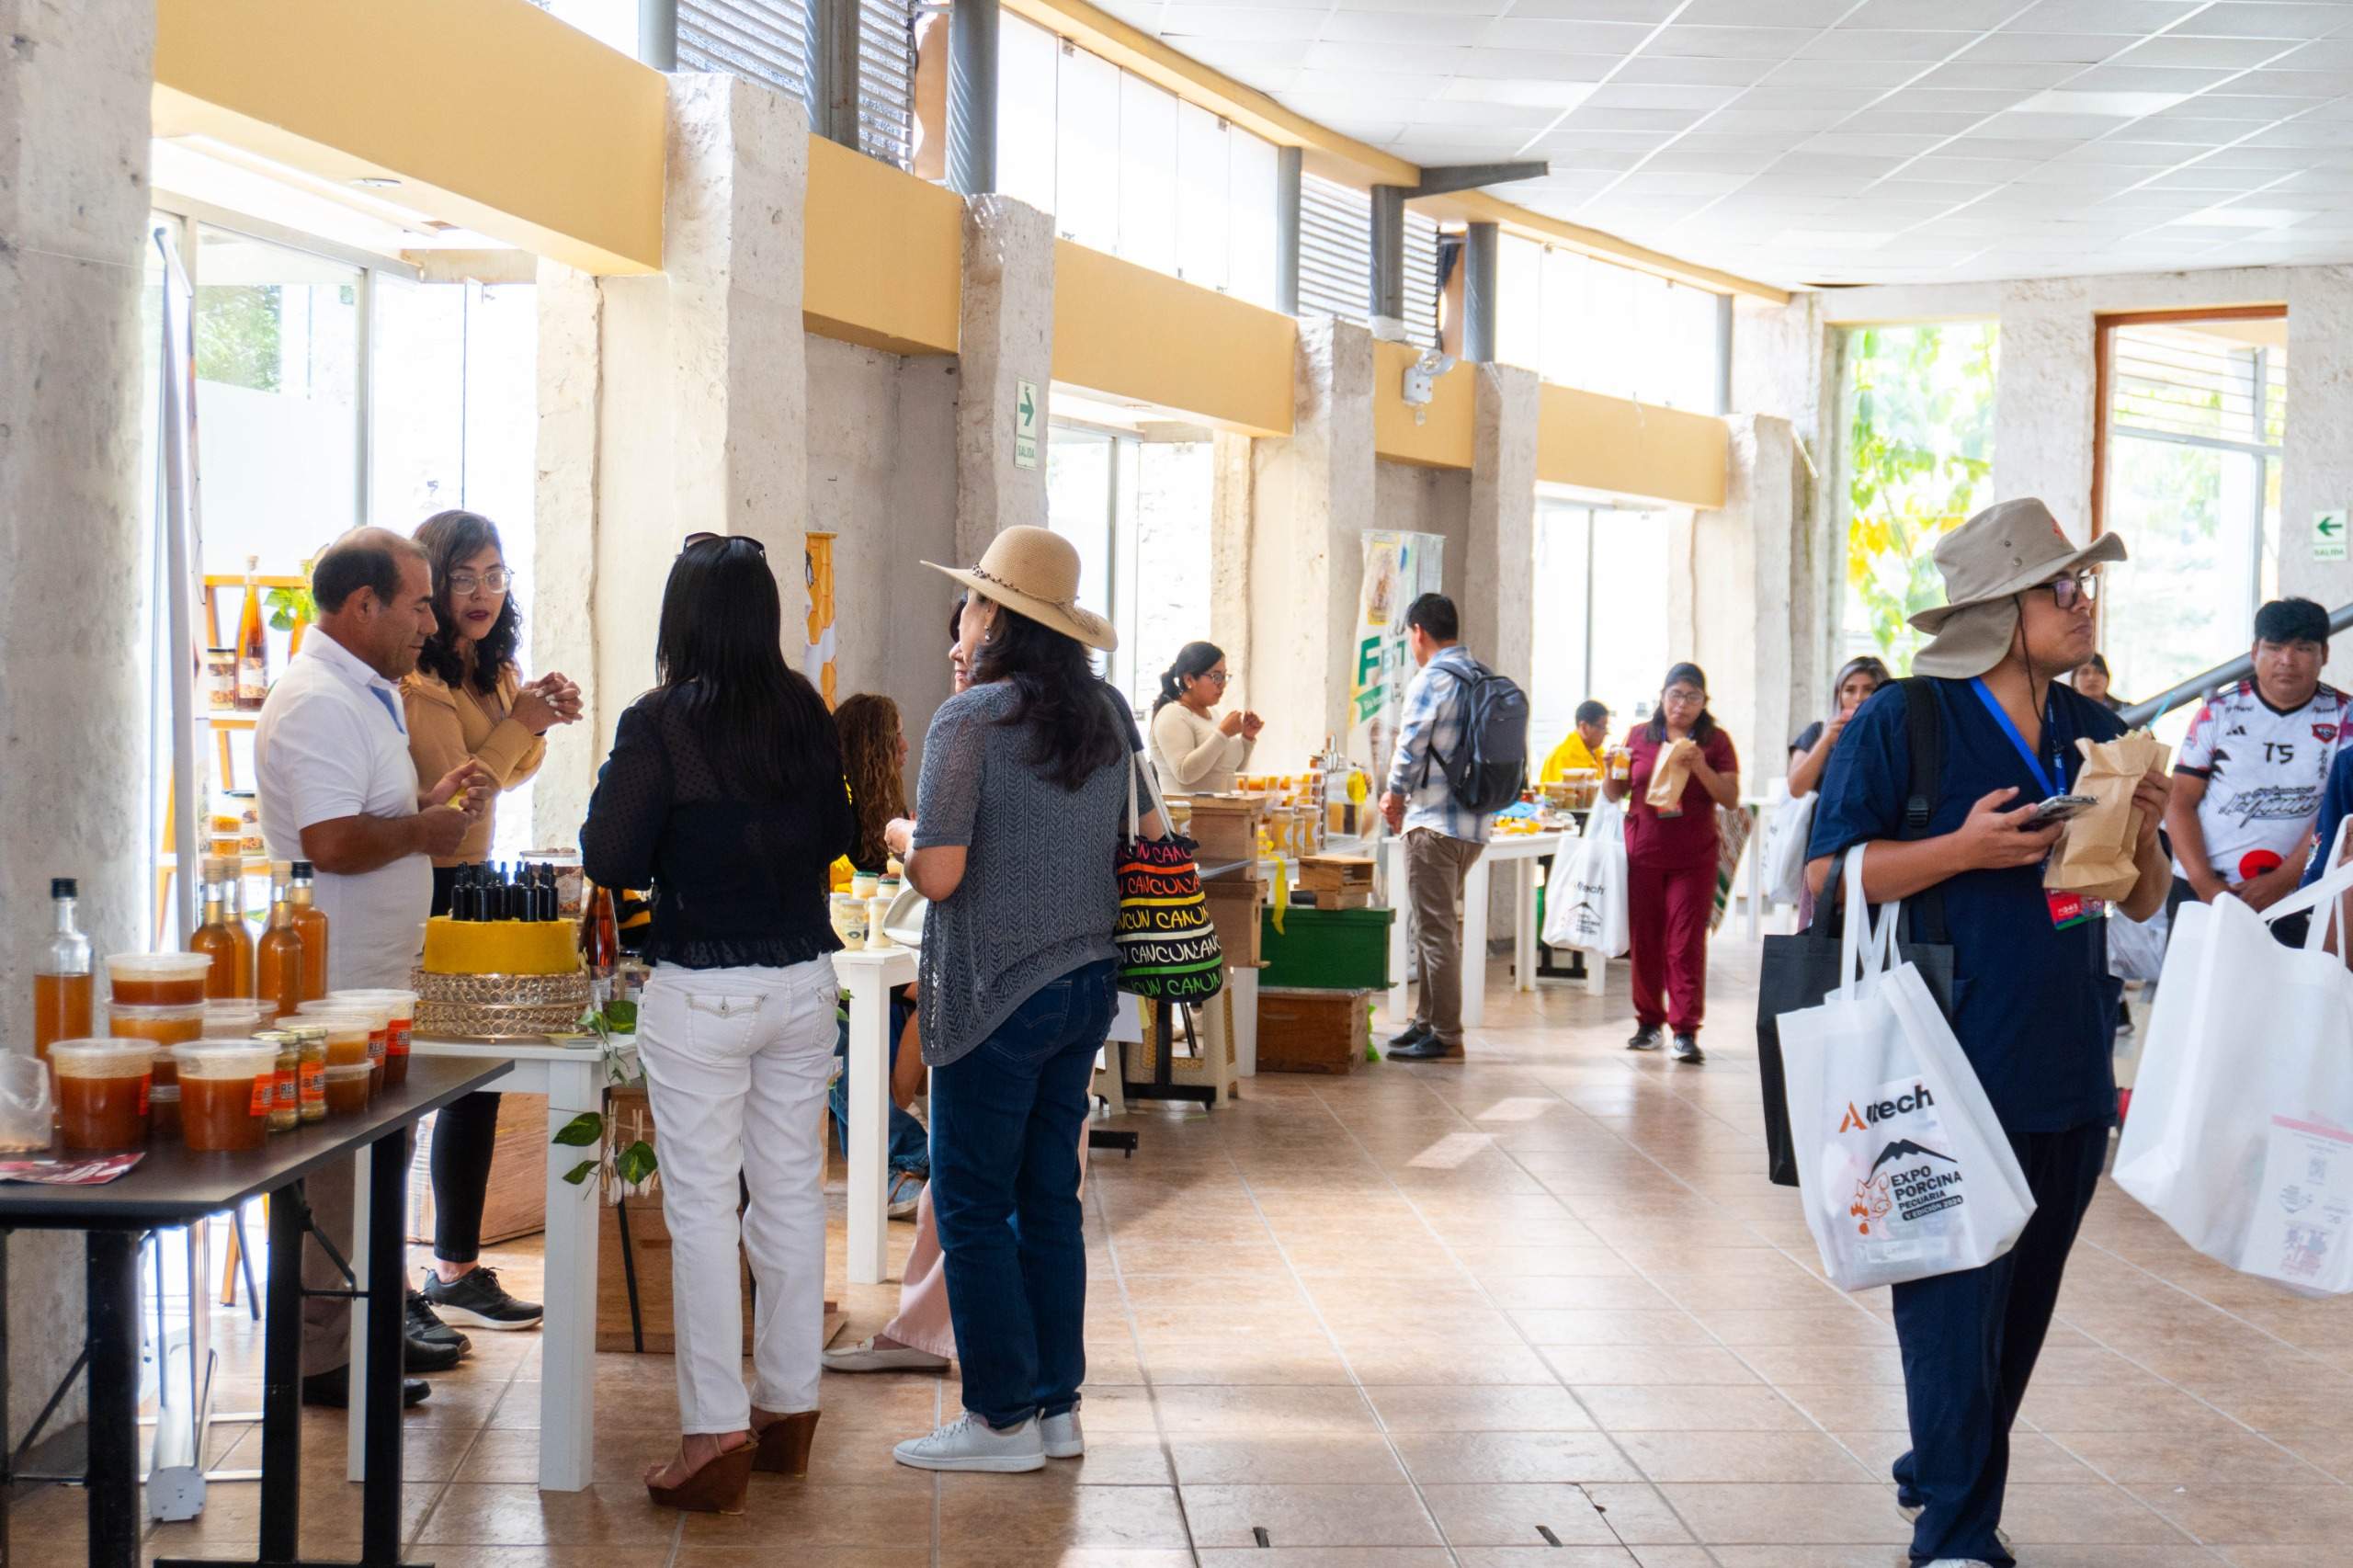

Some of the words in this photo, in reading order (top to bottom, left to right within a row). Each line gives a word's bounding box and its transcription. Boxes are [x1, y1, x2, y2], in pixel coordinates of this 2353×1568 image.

[1891, 1165, 1931, 1187] EXPO
[1894, 1170, 1963, 1201] PORCINA
[1898, 1189, 1947, 1211] PECUARIA
